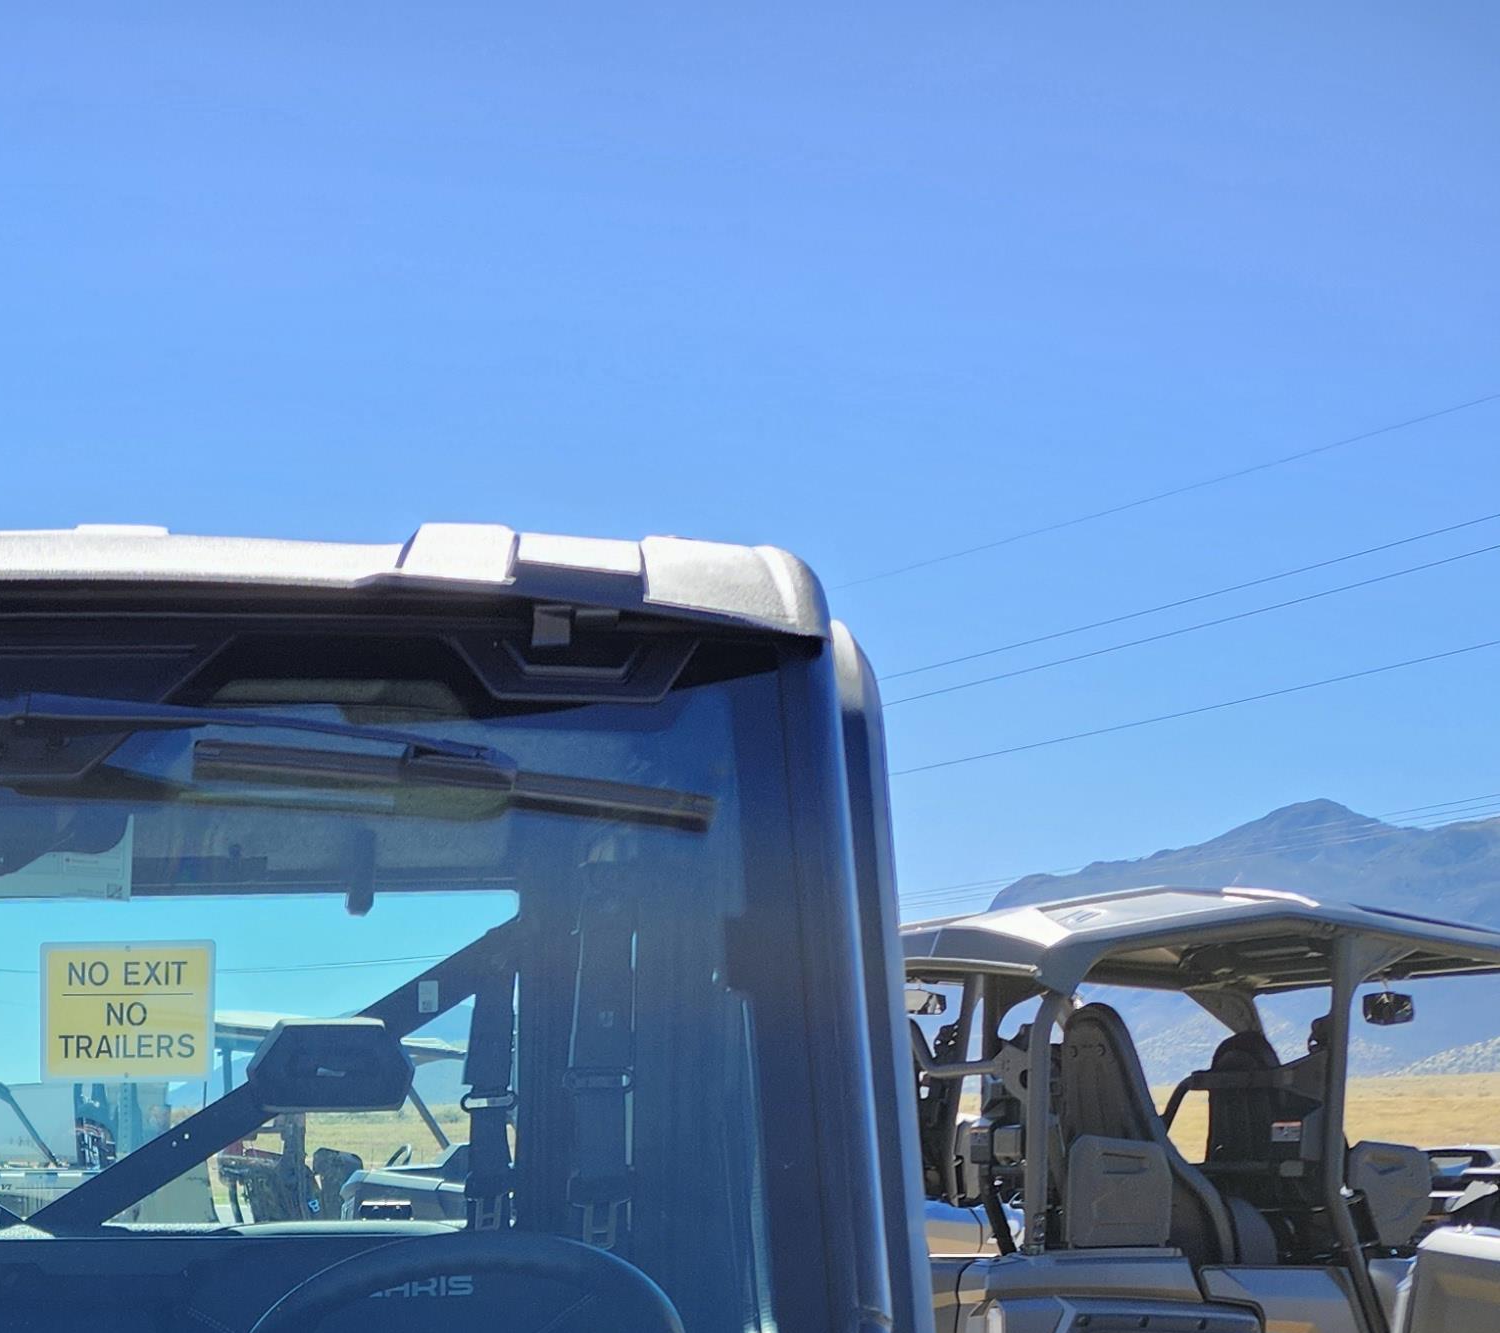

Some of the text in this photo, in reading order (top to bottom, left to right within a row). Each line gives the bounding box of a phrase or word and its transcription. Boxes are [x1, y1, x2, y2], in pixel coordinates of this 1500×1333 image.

[68, 961, 188, 986] NO EXIT
[106, 1001, 147, 1026] NO
[58, 1033, 195, 1059] TRAILERS
[369, 1275, 474, 1297] ARIS
